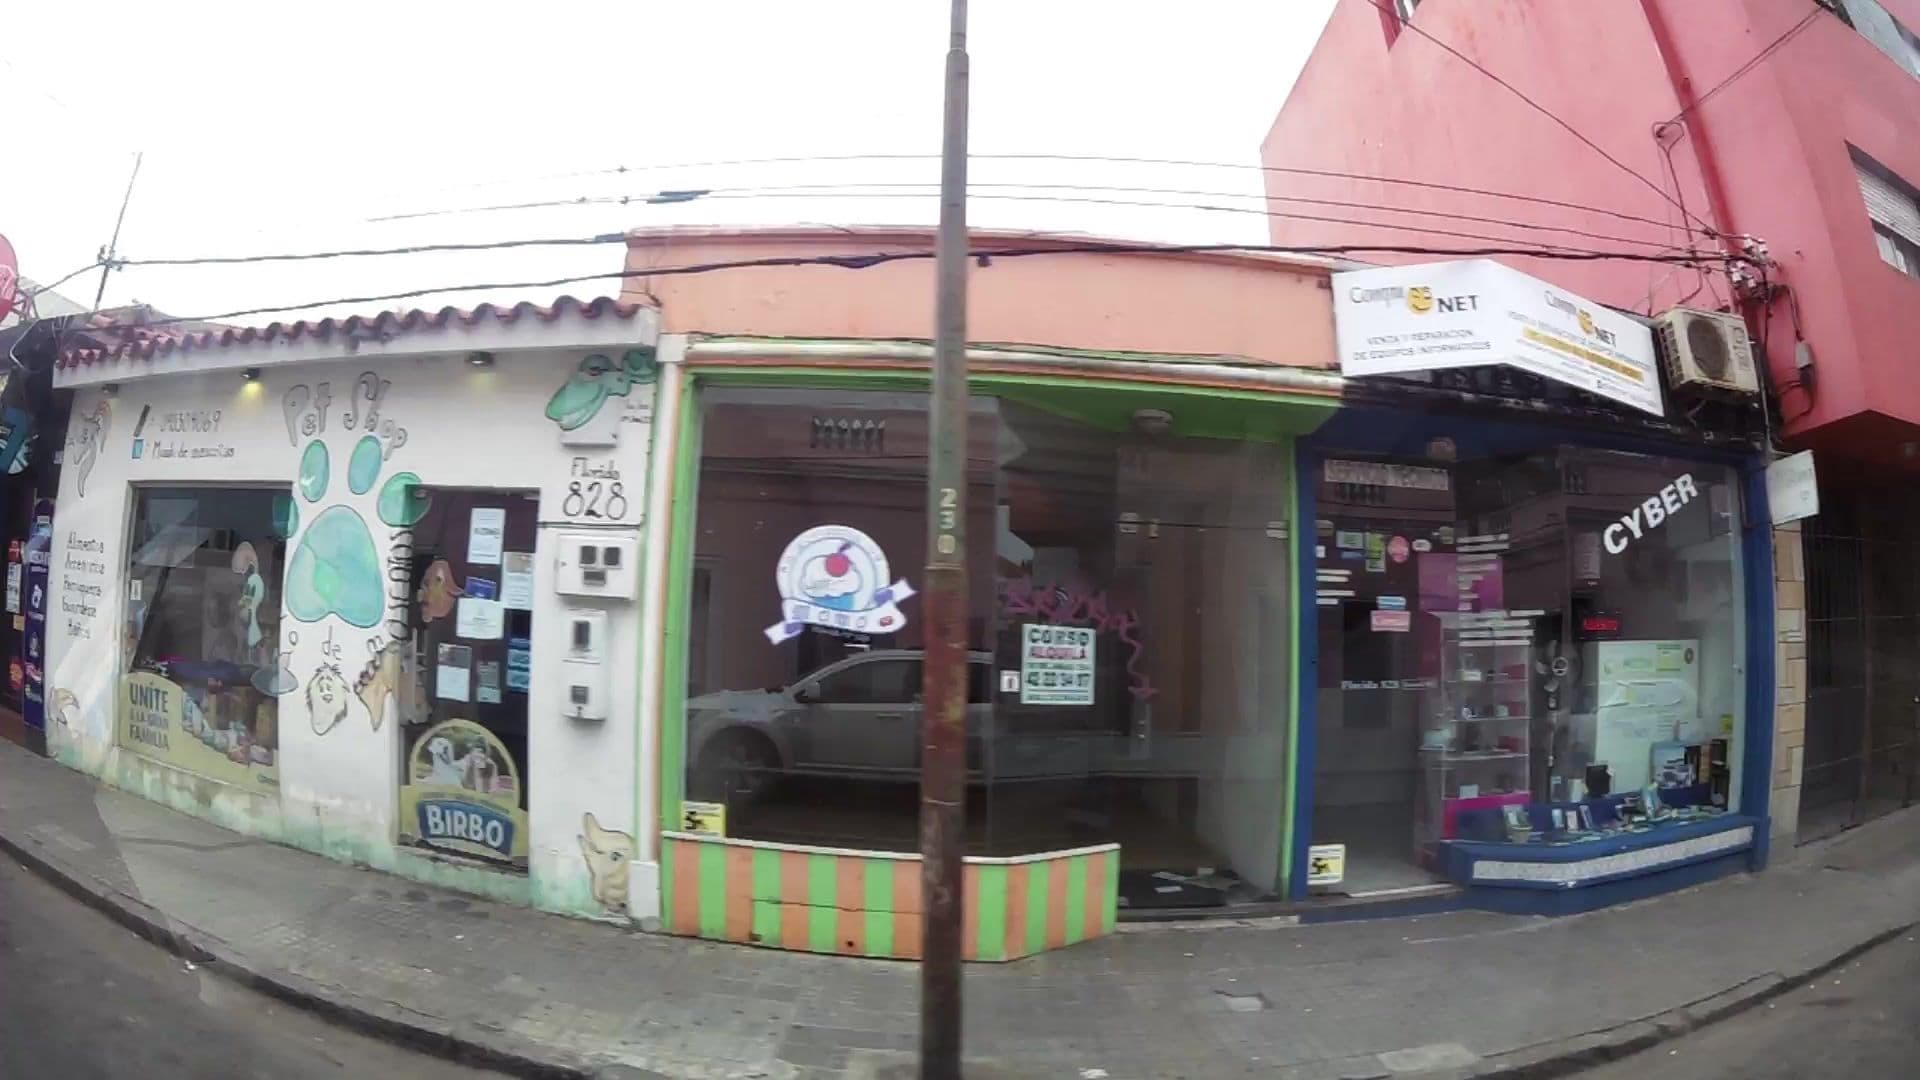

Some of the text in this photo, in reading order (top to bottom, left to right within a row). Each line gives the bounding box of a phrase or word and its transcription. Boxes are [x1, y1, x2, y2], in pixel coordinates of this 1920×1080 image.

[1437, 294, 1478, 313] NET
[281, 382, 331, 448] Pet
[562, 481, 628, 520] 828
[1603, 473, 1698, 554] CYBER
[426, 805, 504, 848] BIRBO
